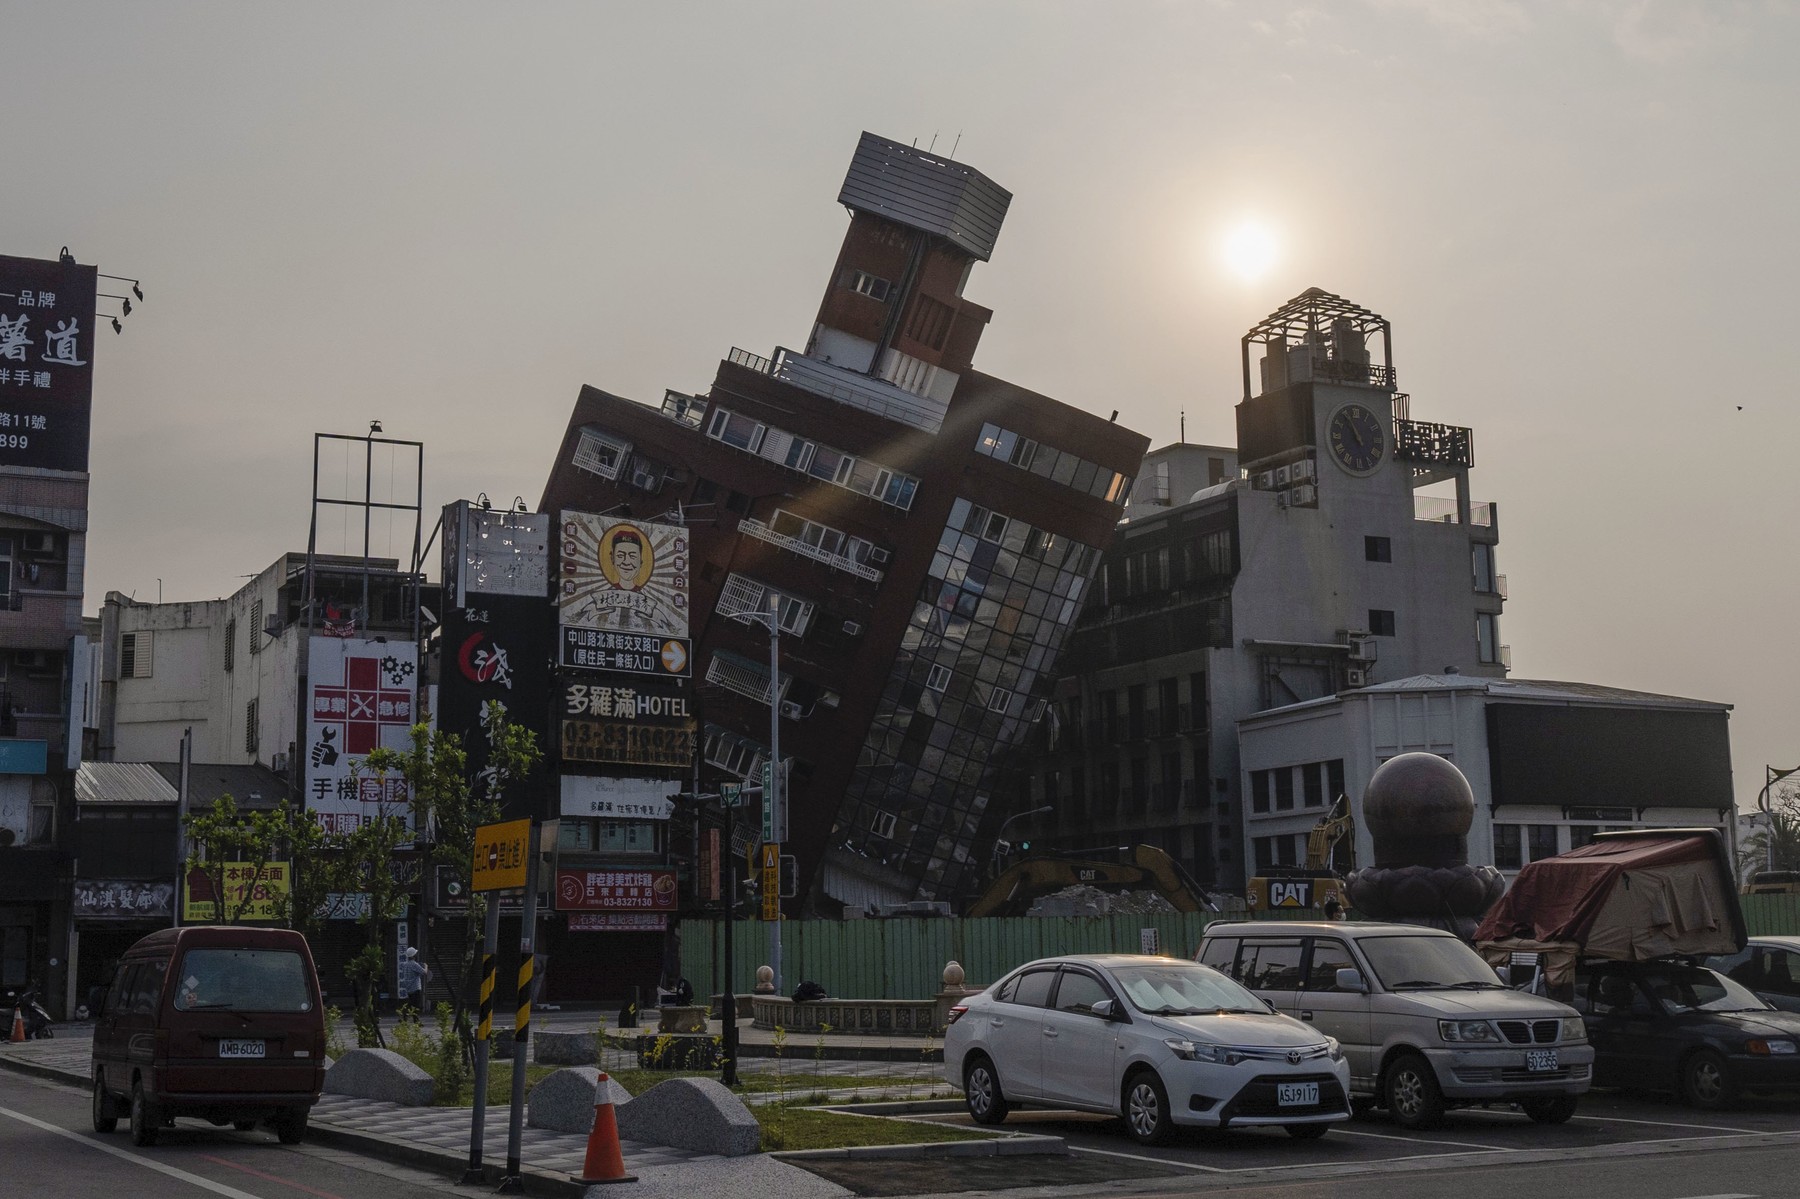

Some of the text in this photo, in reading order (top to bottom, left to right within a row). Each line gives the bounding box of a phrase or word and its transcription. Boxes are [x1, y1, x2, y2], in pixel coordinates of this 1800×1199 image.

[464, 607, 490, 622] 花蓮
[568, 630, 660, 652] 中山路北濱街交叉路口
[573, 649, 655, 671] (原住民一條街入口)
[315, 696, 410, 717] 專業 急修
[312, 778, 408, 802] 手機急診
[475, 838, 527, 872] 出口 禁止進入
[586, 872, 652, 887] 胖老爹美式炸雞
[1080, 869, 1096, 881] CAT
[79, 890, 152, 910] 仙淇髮廊
[604, 897, 652, 906] 03-8327130
[1271, 882, 1308, 907] CAT
